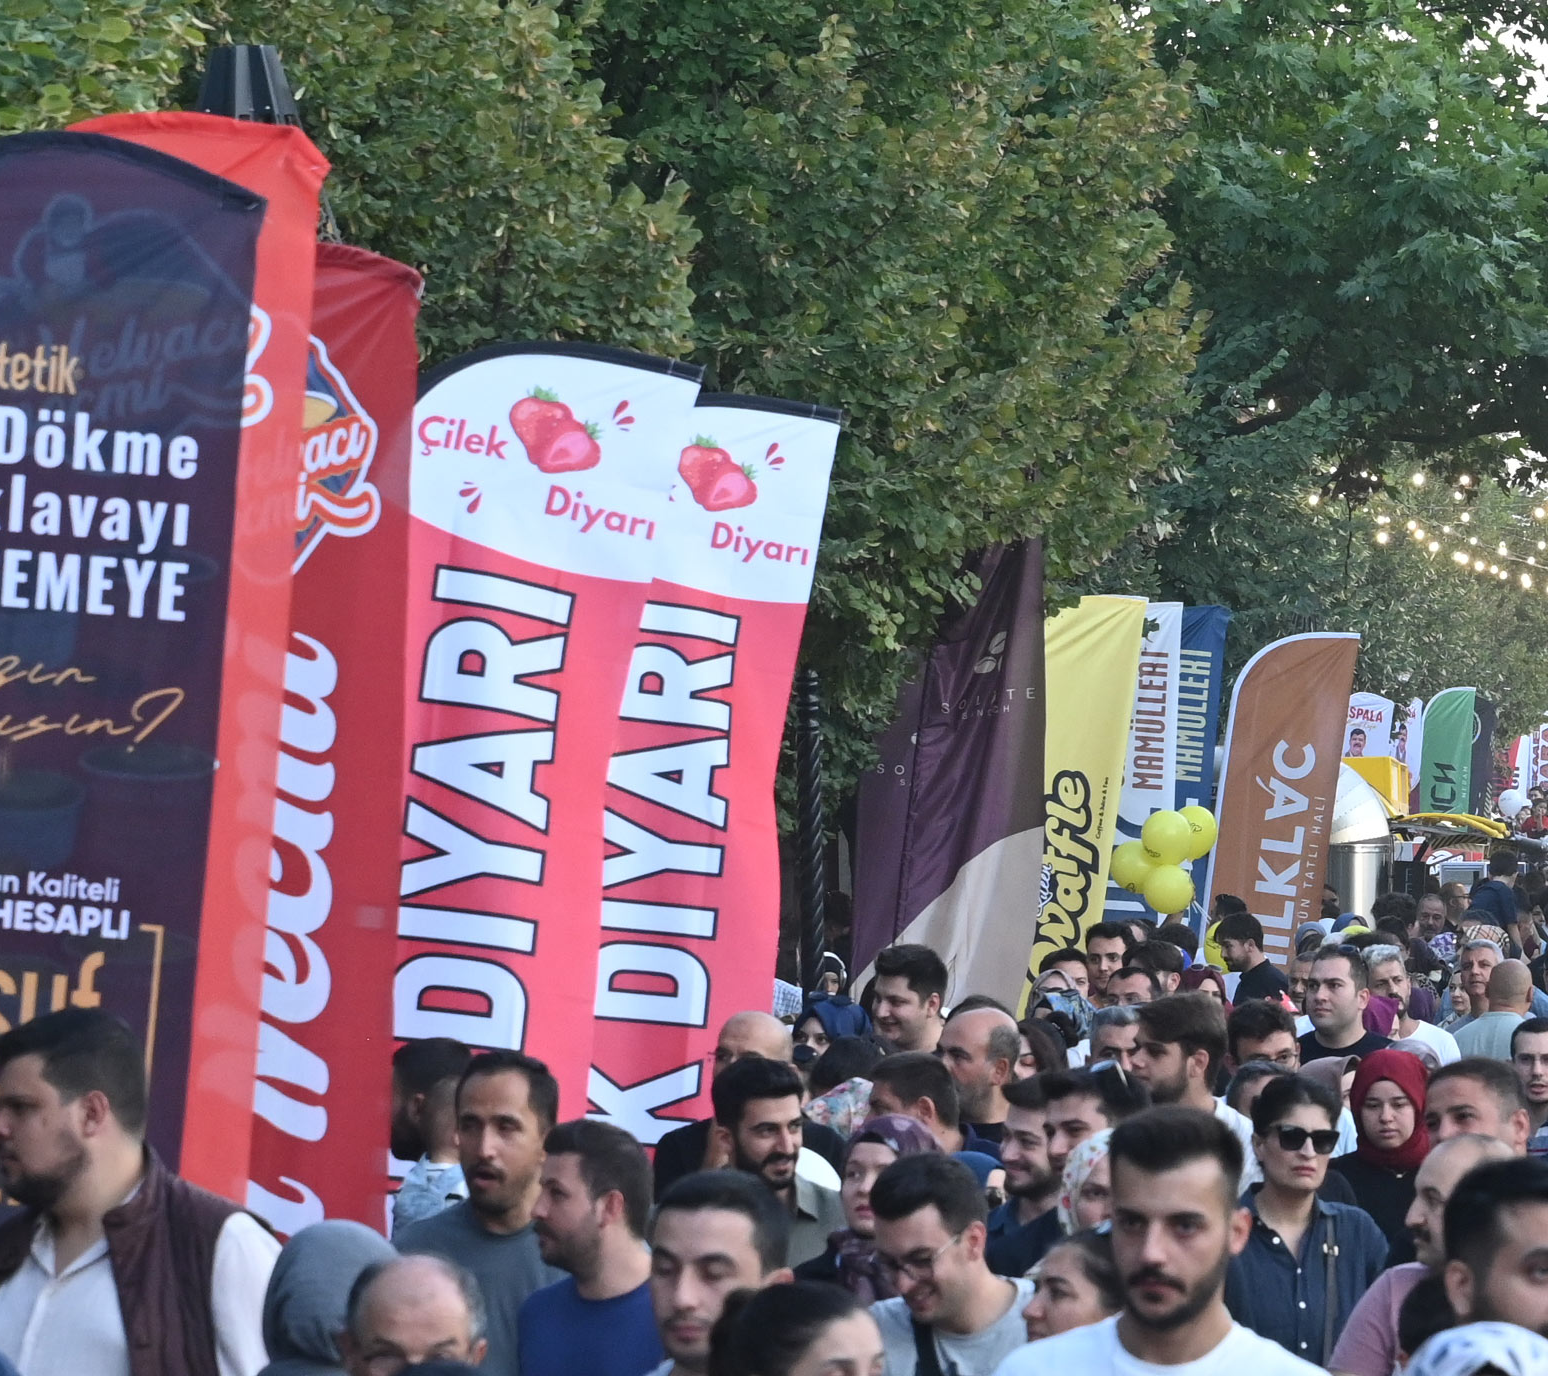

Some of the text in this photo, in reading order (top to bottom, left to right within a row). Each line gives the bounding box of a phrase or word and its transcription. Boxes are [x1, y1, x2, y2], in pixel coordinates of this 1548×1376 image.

[417, 414, 508, 461] Çilek
[544, 484, 656, 542] Diyarı
[709, 520, 809, 567] Diyarı
[1348, 706, 1383, 723] SPALA
[26, 869, 120, 904] Kaliteli
